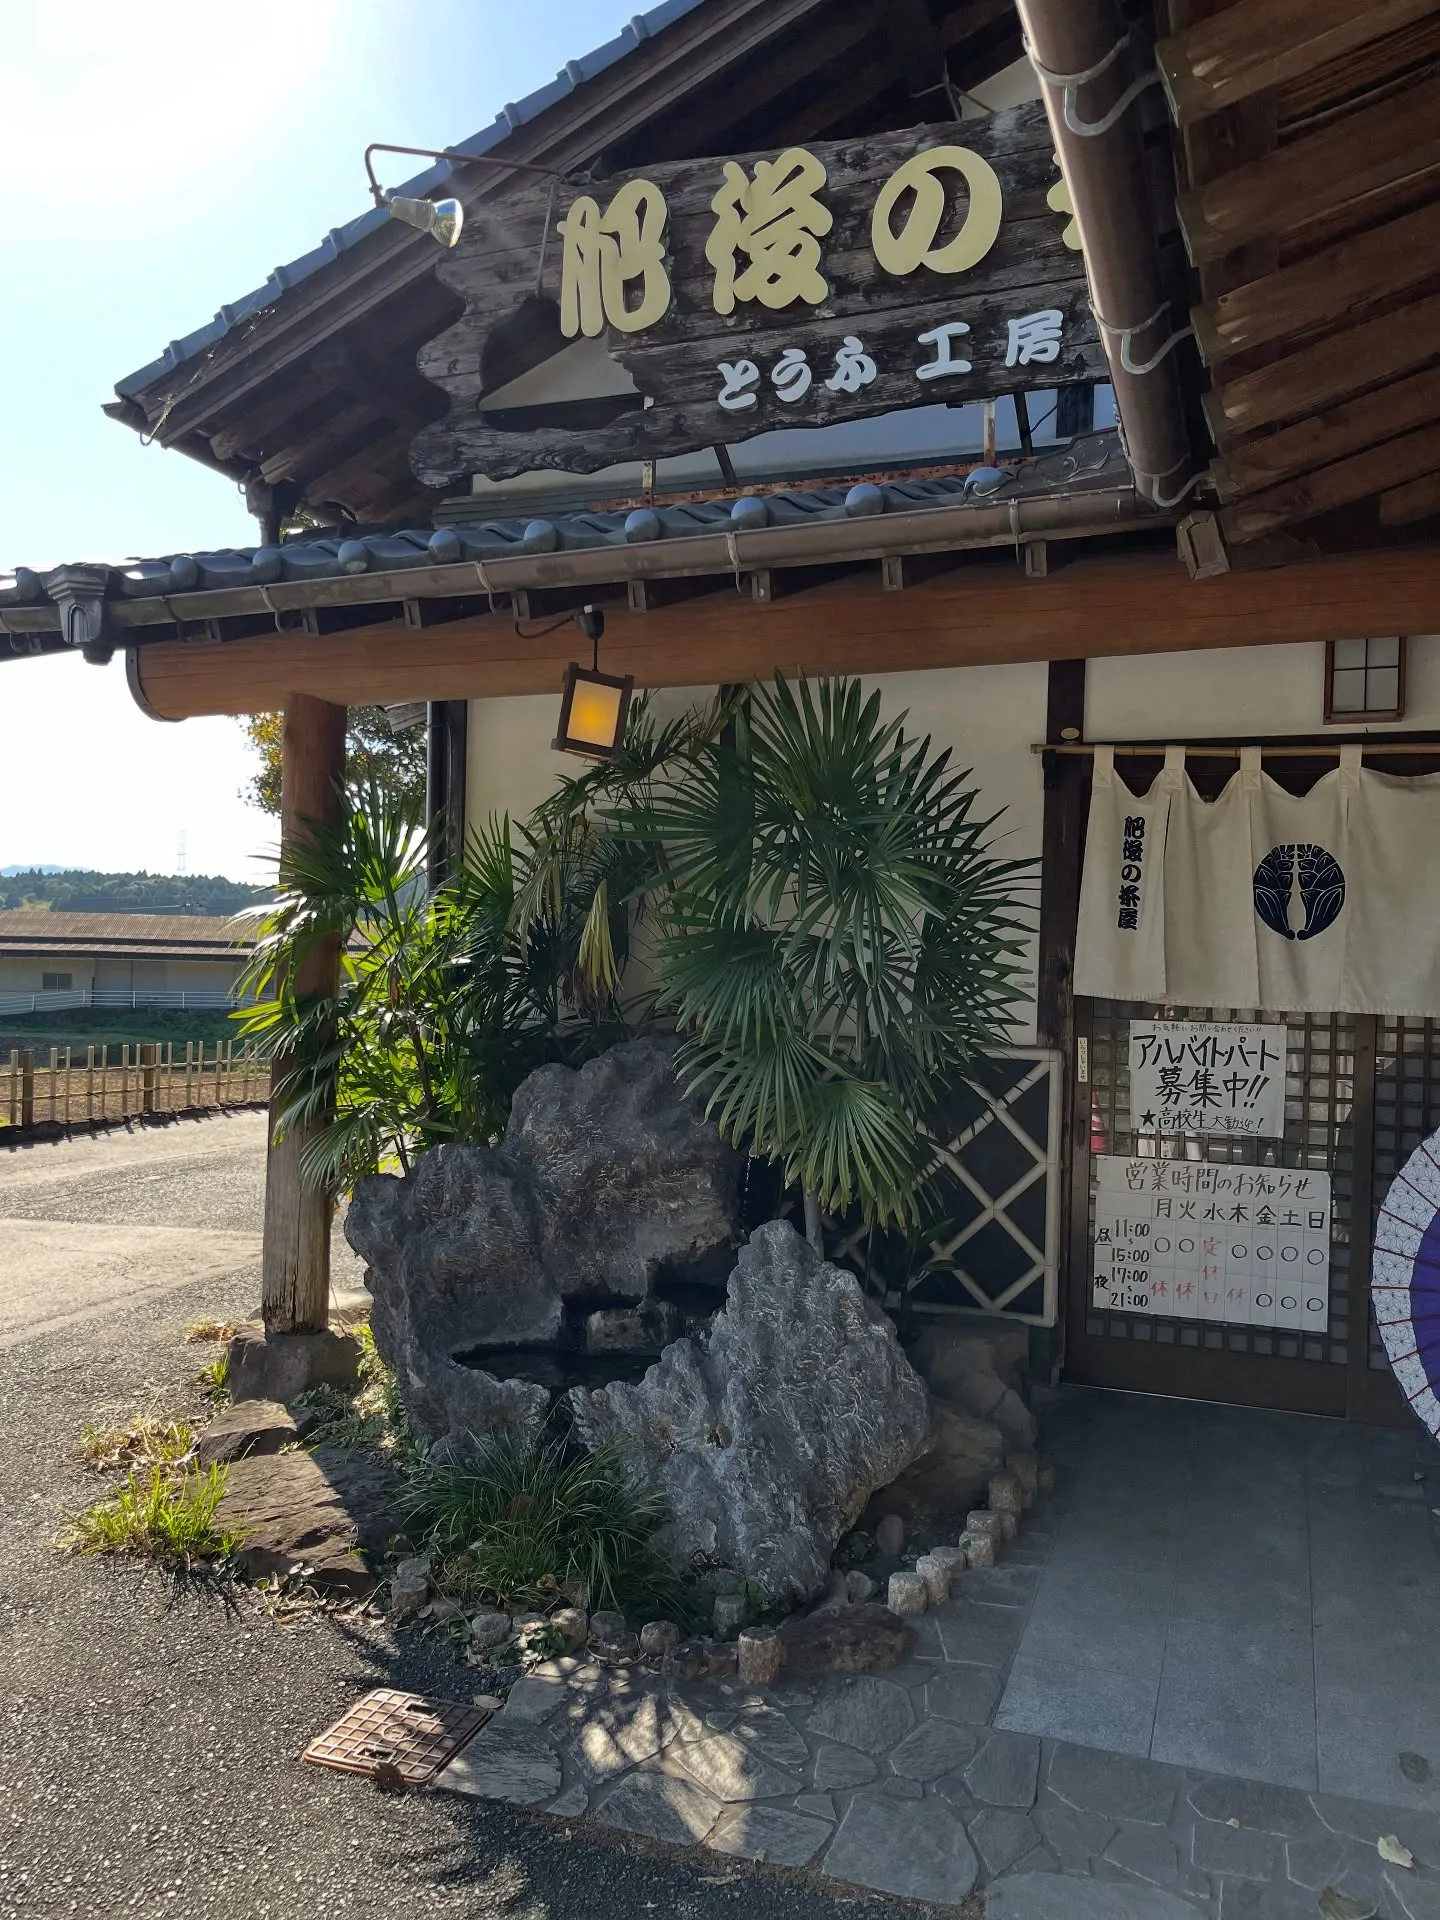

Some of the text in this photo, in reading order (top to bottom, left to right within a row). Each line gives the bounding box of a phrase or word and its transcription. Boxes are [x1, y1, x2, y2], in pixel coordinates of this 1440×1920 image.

[1125, 1160, 1317, 1200] 営業時間のお知らせ
[1156, 1198, 1326, 1230] 月 火 水 木 金 土 日
[1115, 1218, 1151, 1238] 11:00
[1111, 1247, 1150, 1263] 15:00
[1094, 1274, 1110, 1290] 夜
[1111, 1266, 1149, 1284] 17:00
[1151, 1280, 1169, 1298] 休
[1175, 1282, 1195, 1300] 休
[1110, 1292, 1149, 1308] 21:00
